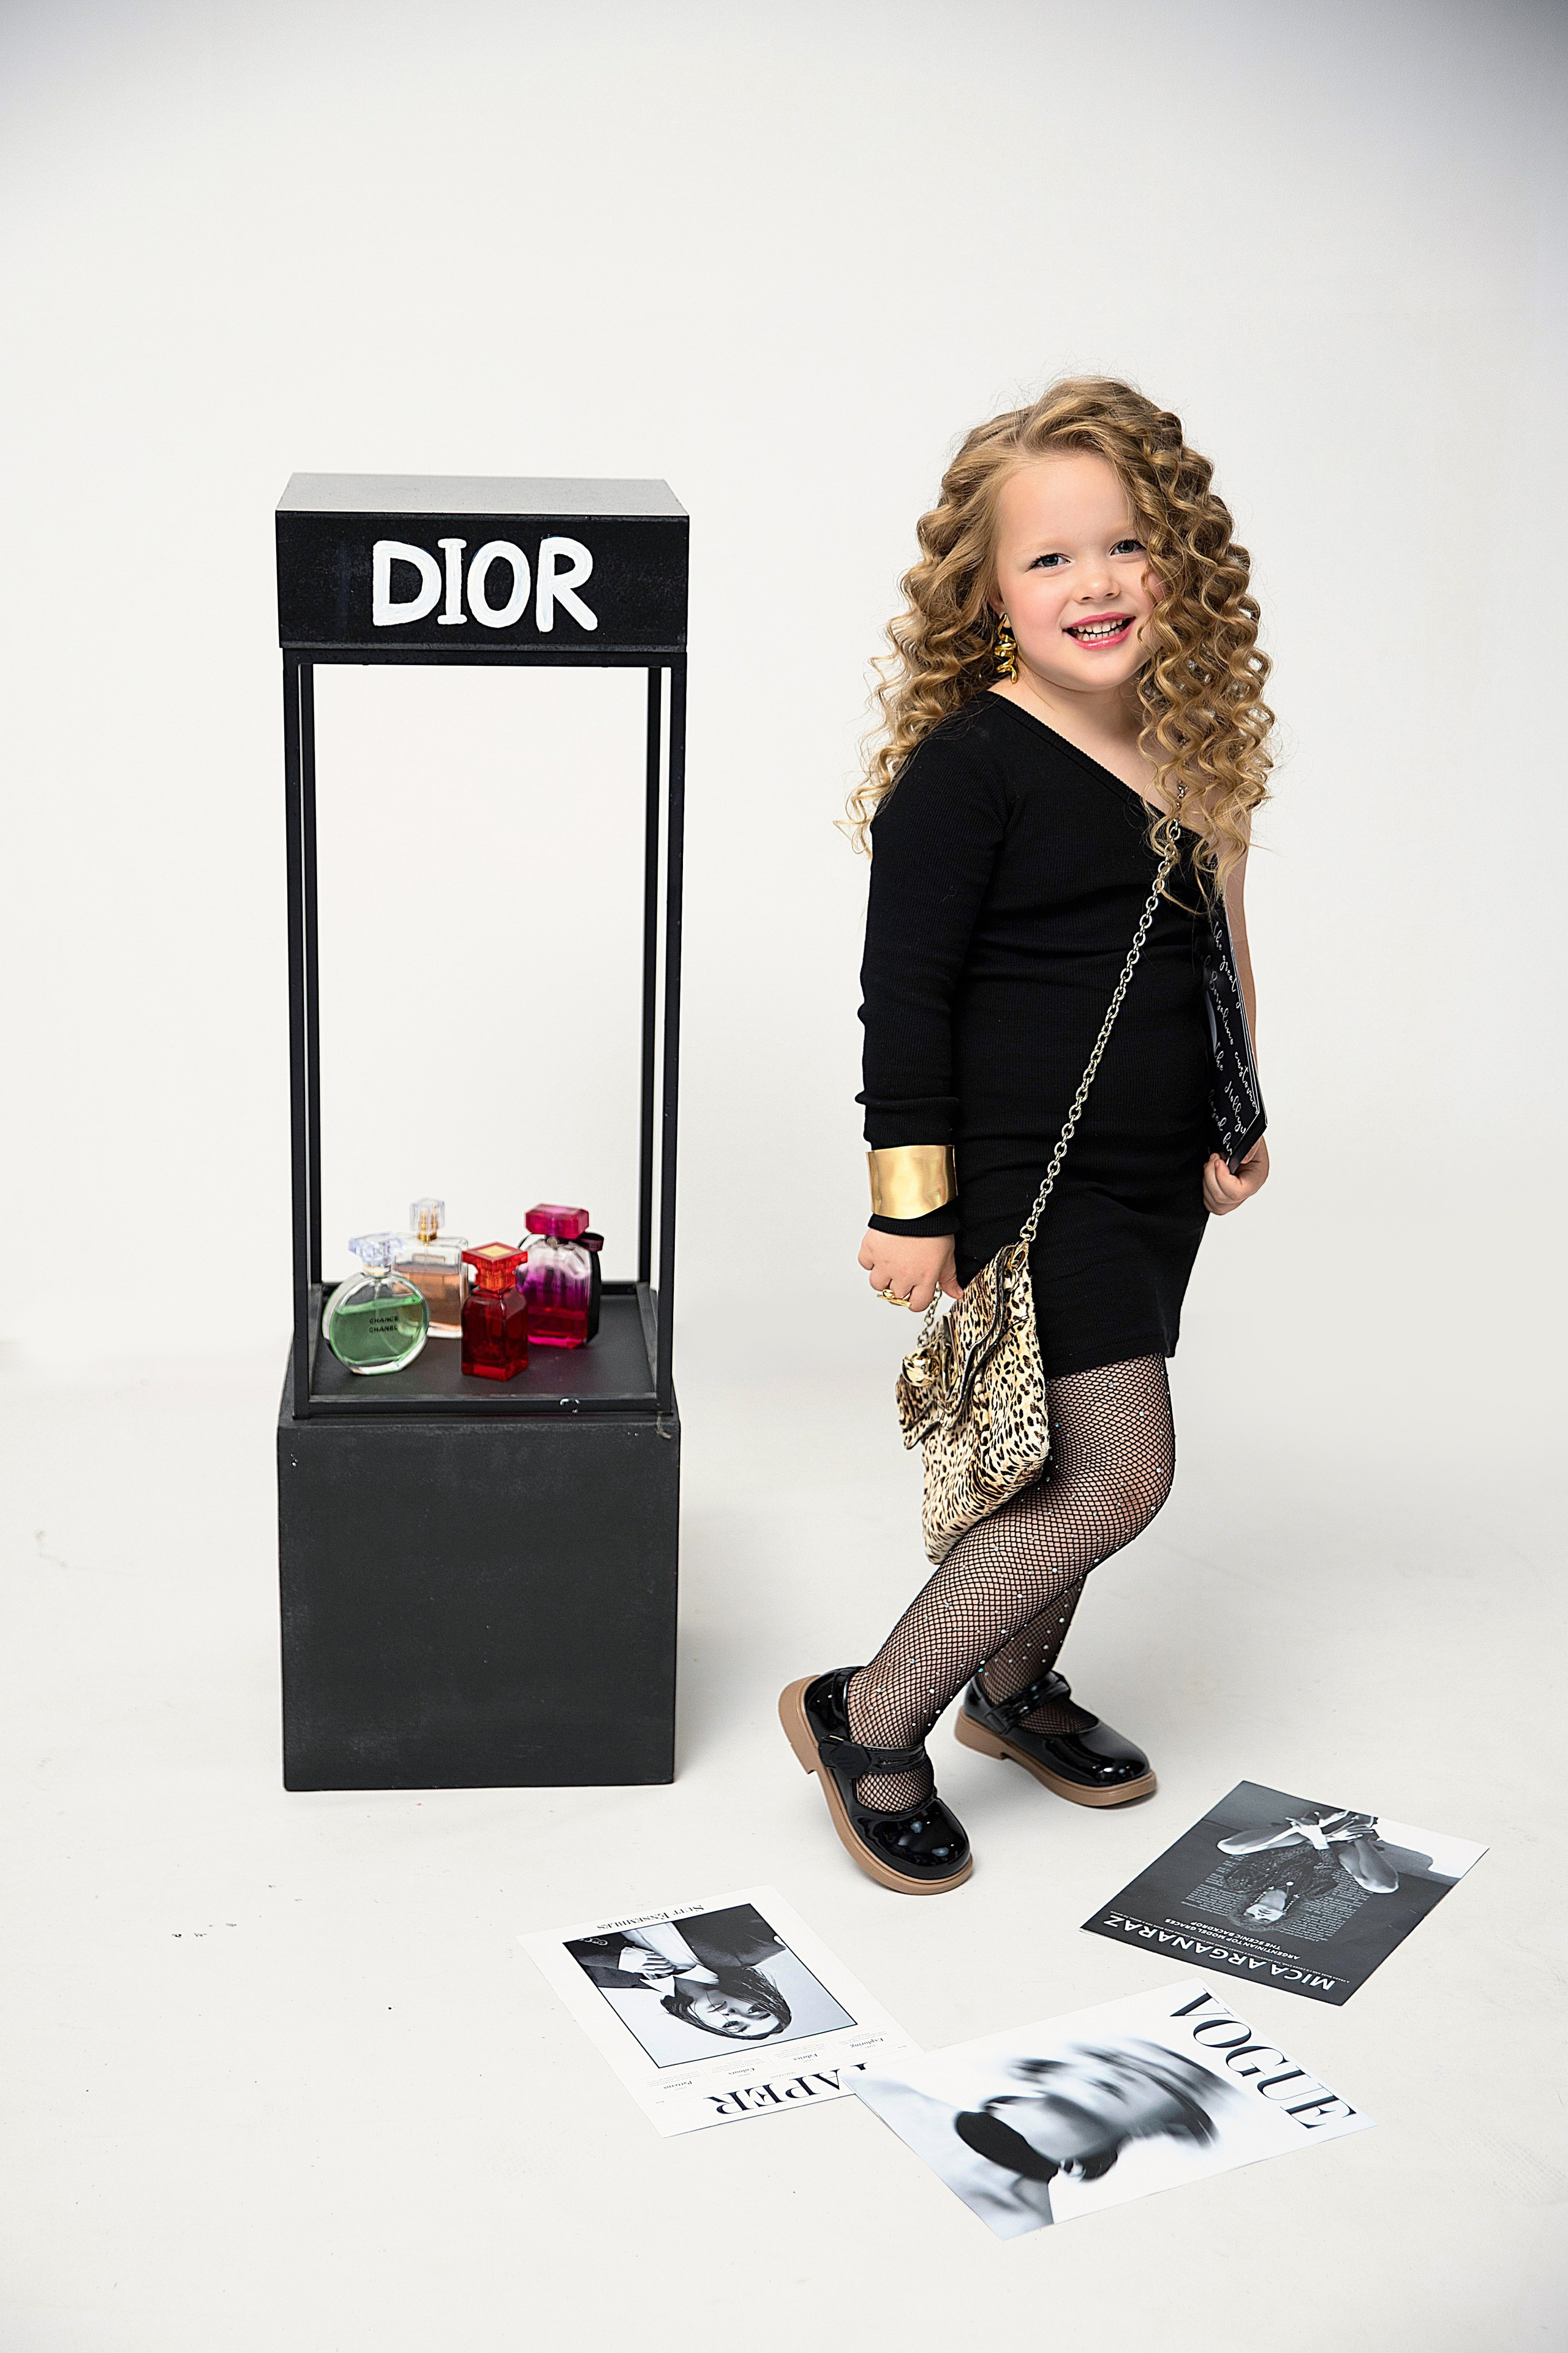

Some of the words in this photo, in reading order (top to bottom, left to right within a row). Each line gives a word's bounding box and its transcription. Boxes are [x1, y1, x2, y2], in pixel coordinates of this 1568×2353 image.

[373, 537, 598, 633] DIOR
[1165, 1919, 1196, 1930] GRACES
[1191, 1922, 1235, 1936] BACKDROP
[1198, 1928, 1226, 1939] MODEL
[1235, 1935, 1265, 1945] SCENIC
[1104, 1915, 1267, 1969] ARGANARAZ
[1243, 1942, 1300, 1959] ARGENTINIAN
[1270, 1964, 1336, 1990] MICA
[848, 2036, 884, 2049] Exploring
[792, 2052, 818, 2062] Fabrics
[1169, 1988, 1357, 2129] VOGUE
[727, 2066, 755, 2077] Colours
[662, 2080, 693, 2090] Patterns
[703, 2063, 867, 2114] APER
